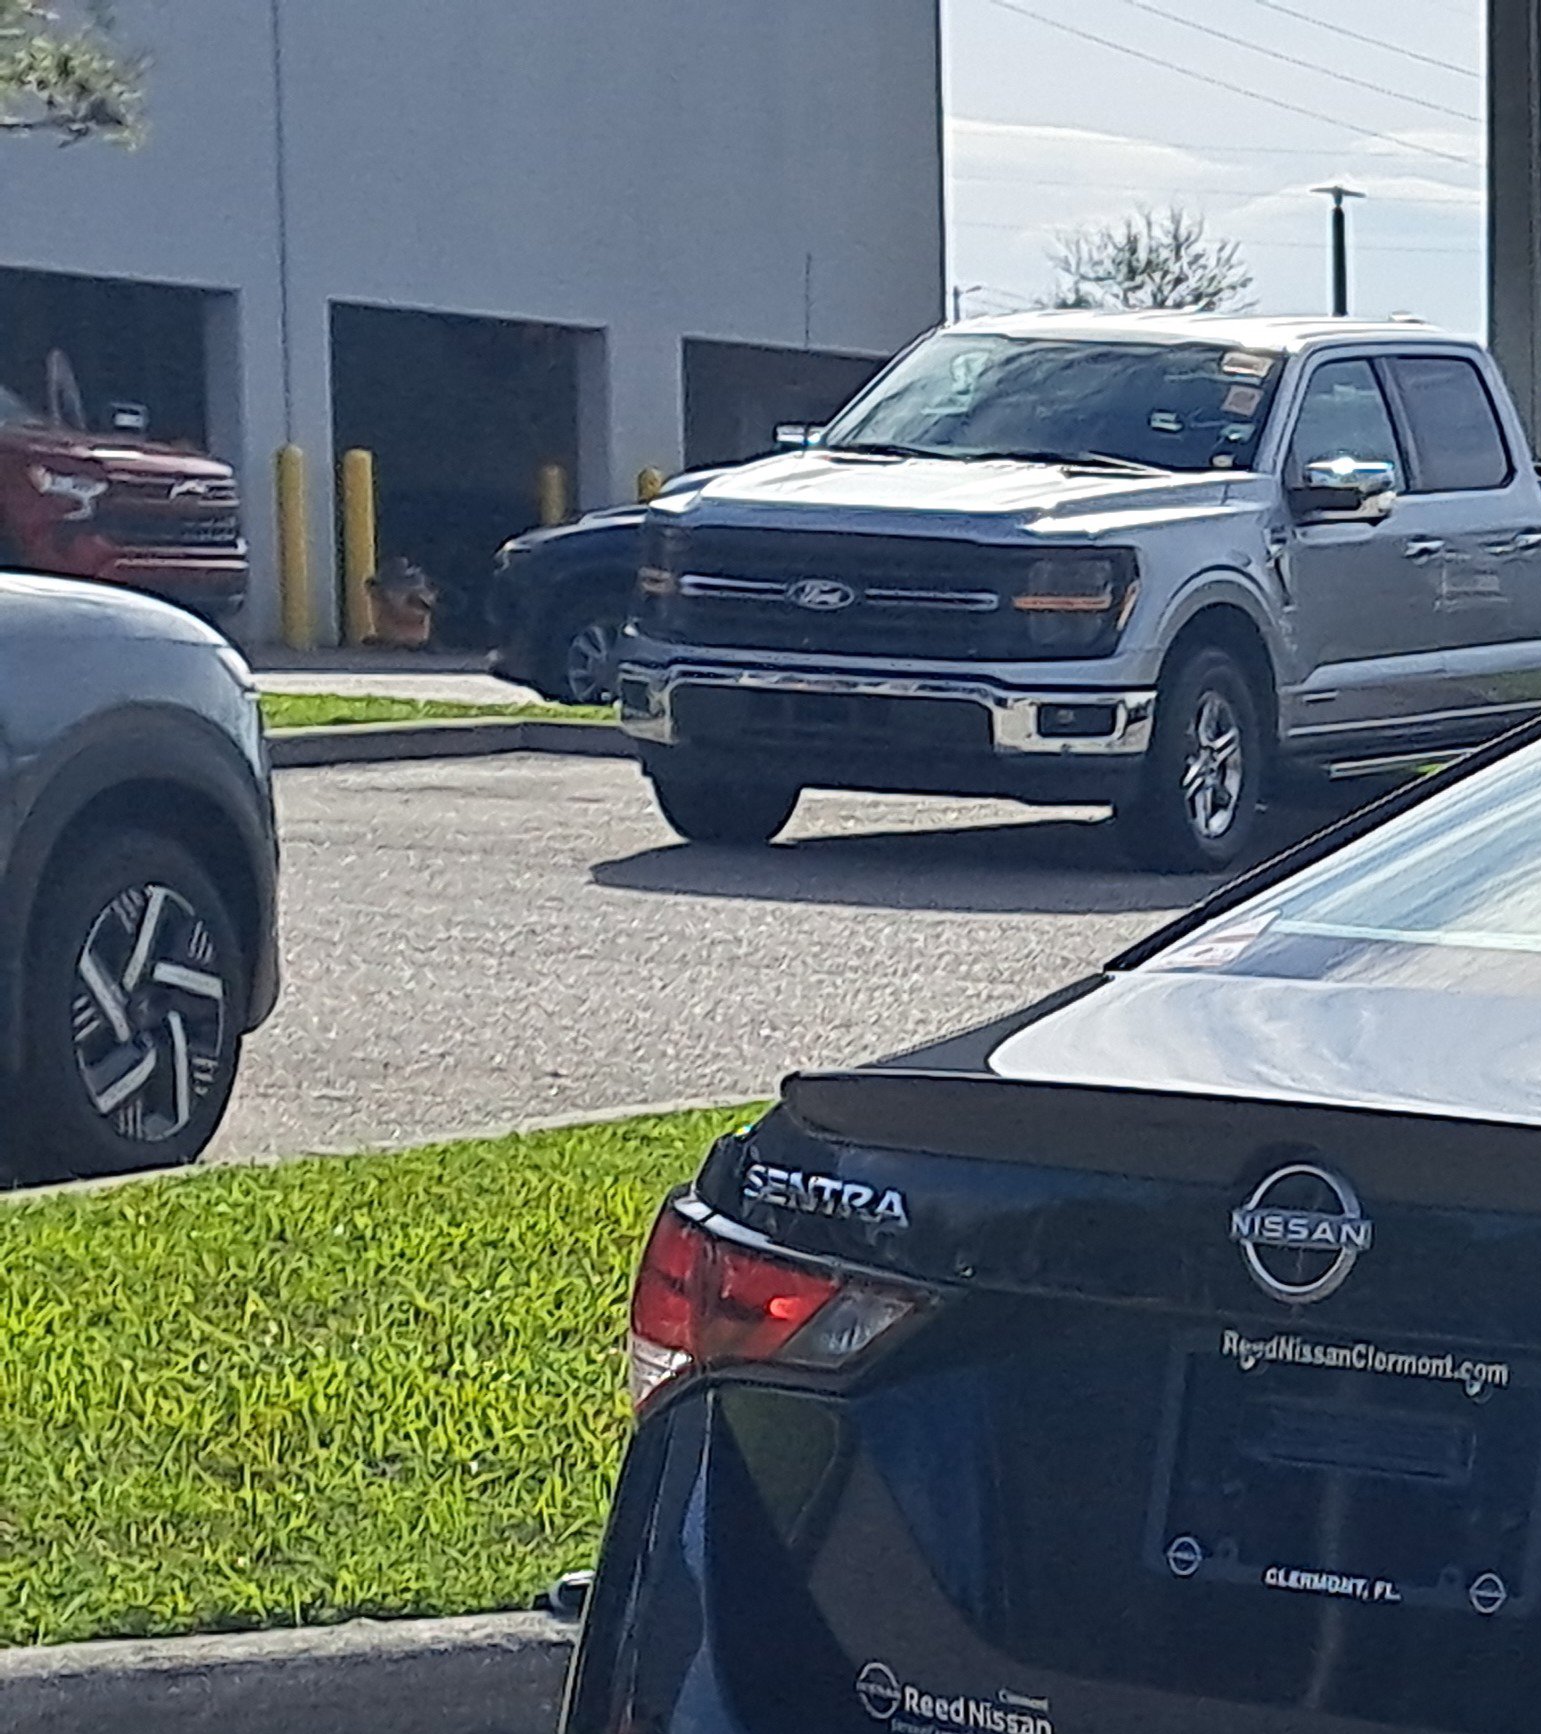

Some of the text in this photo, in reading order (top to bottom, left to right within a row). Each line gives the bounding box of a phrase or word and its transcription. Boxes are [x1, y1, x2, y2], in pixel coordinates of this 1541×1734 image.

[744, 1163, 910, 1228] SENTRA
[1231, 1213, 1365, 1247] NISSAN
[1374, 1580, 1401, 1600] FL
